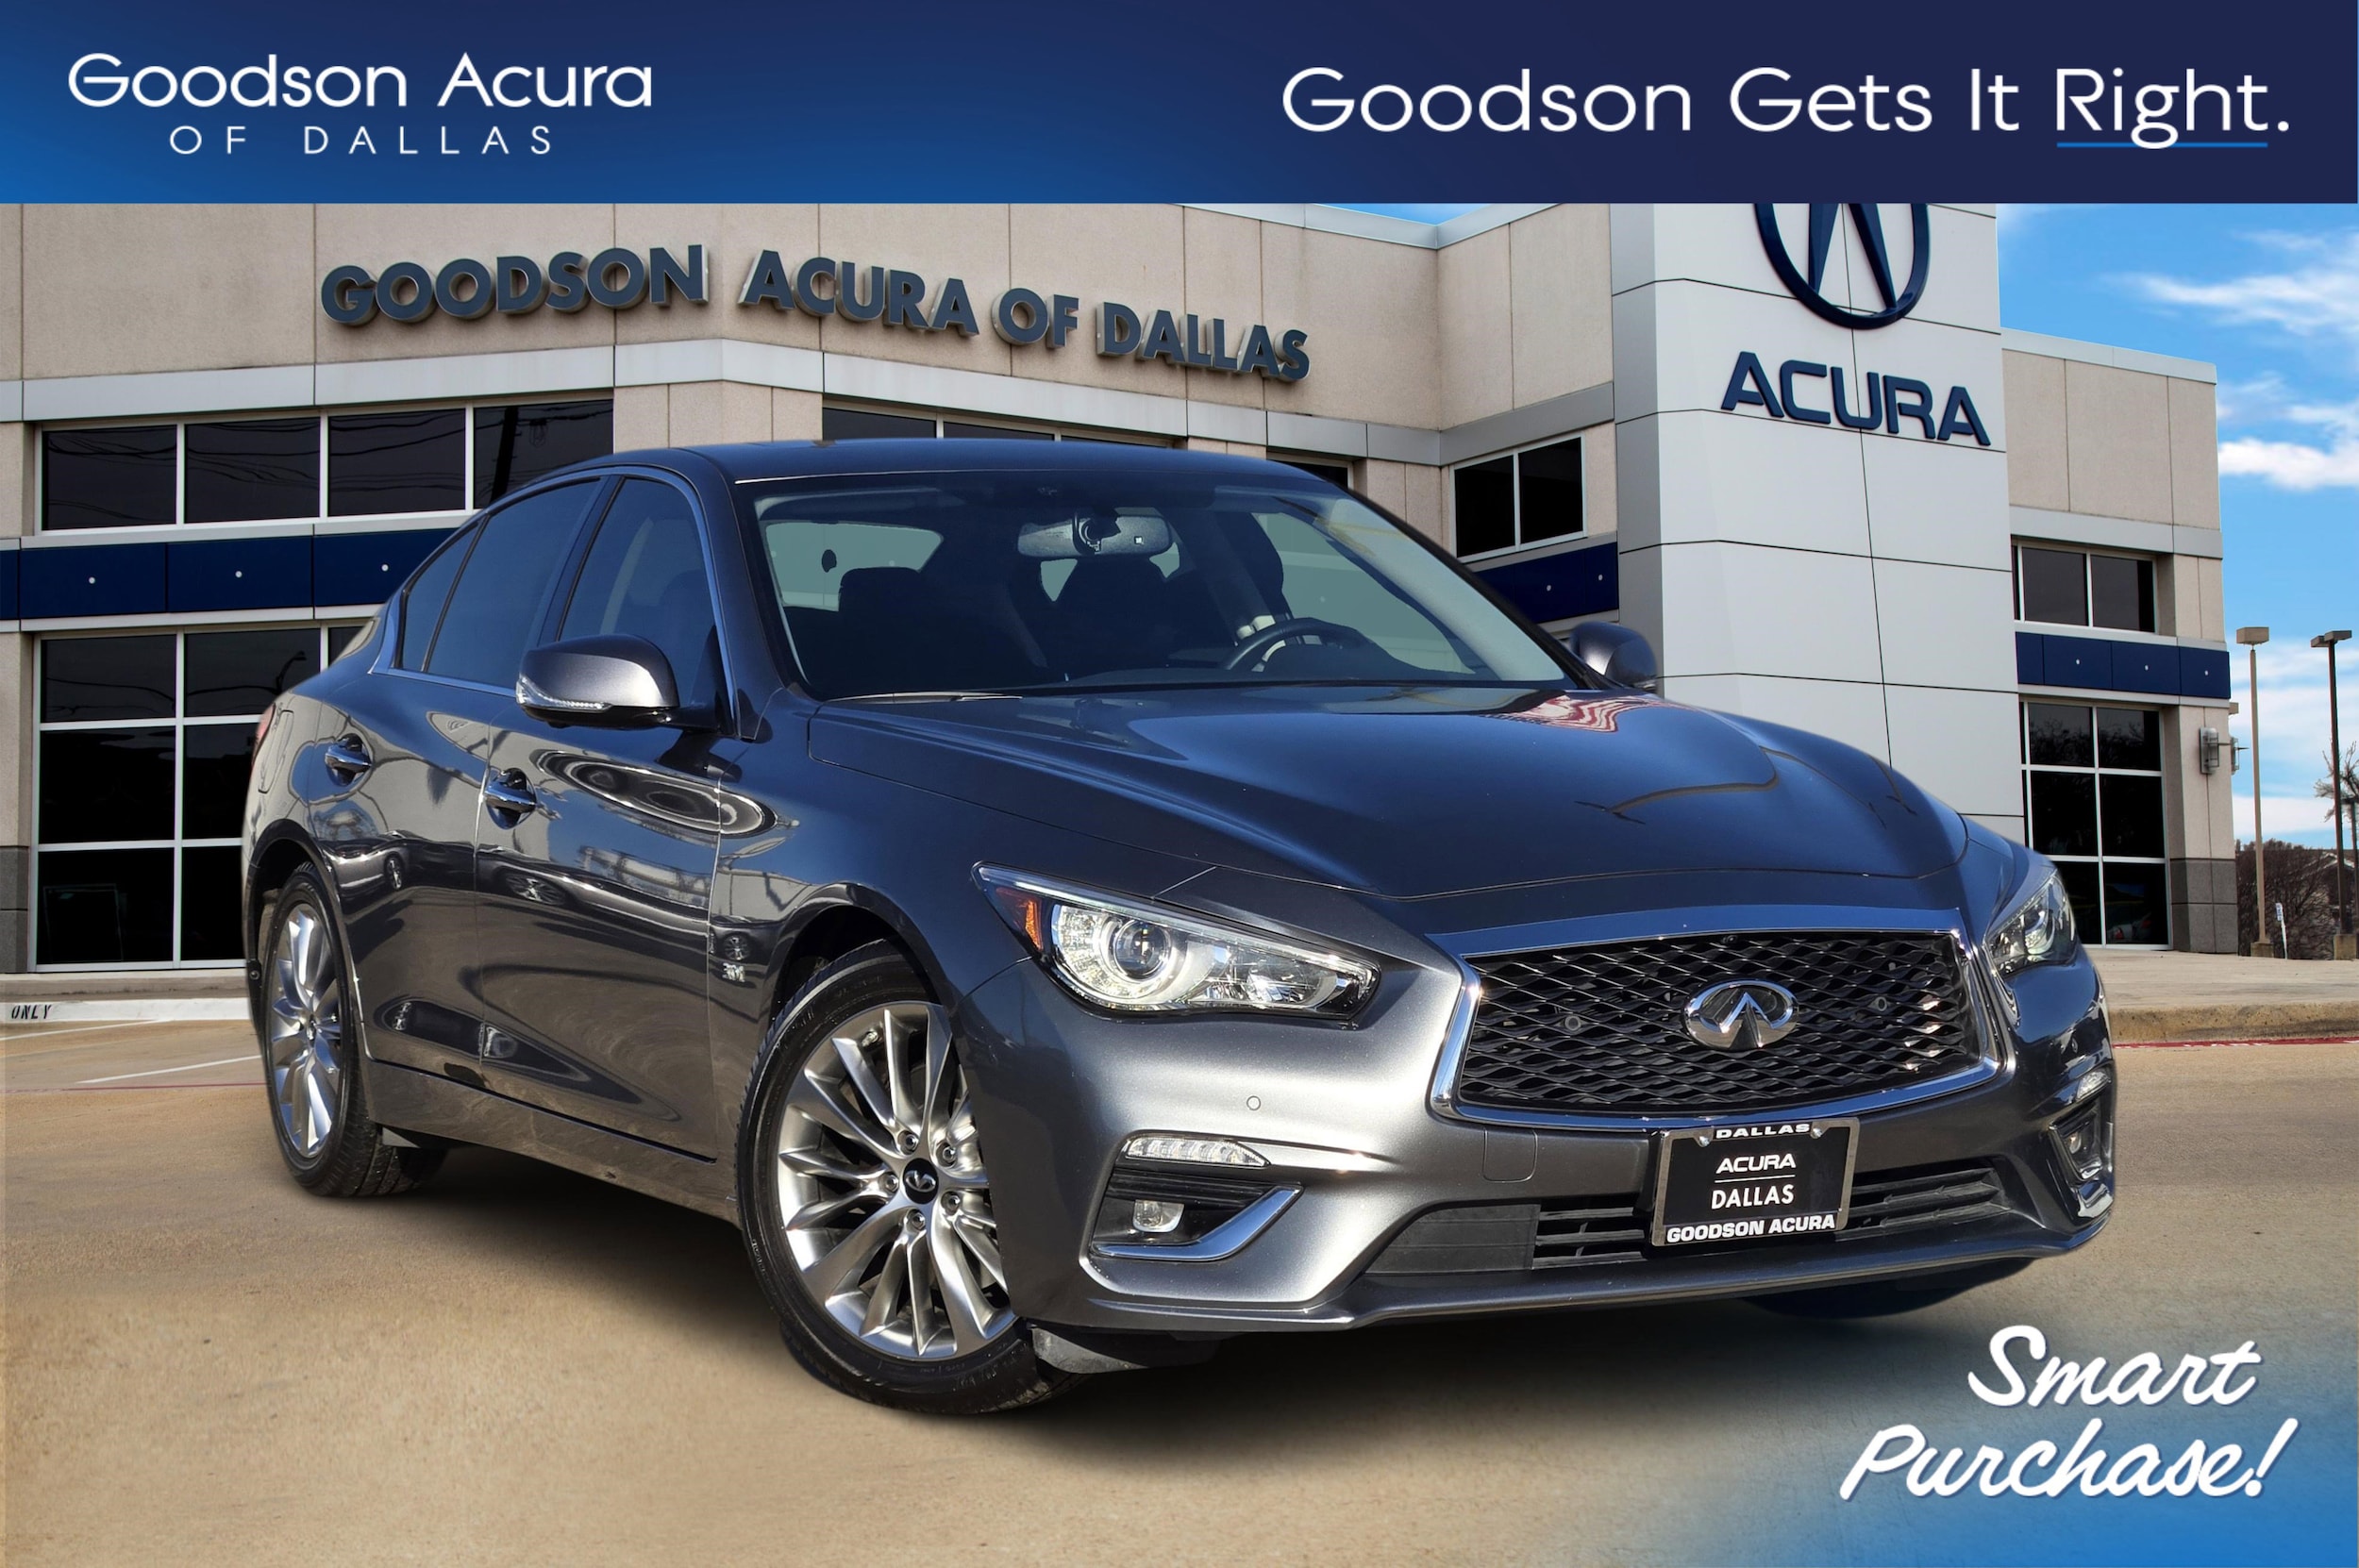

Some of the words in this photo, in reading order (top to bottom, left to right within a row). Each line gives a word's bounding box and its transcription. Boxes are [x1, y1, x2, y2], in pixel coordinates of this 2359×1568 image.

[321, 243, 710, 327] GOODSON
[739, 249, 979, 337] ACURA
[992, 287, 1079, 347] OF
[1096, 300, 1311, 382] DALLAS
[1720, 350, 1992, 446] ACURA
[11, 1003, 52, 1020] ONLY
[1715, 1123, 1811, 1140] DALLAS
[1715, 1153, 1797, 1175] ACURA
[1711, 1184, 1795, 1209] DALLAS
[1666, 1218, 1765, 1243] GOODSON
[1767, 1213, 1836, 1235] ACURA
